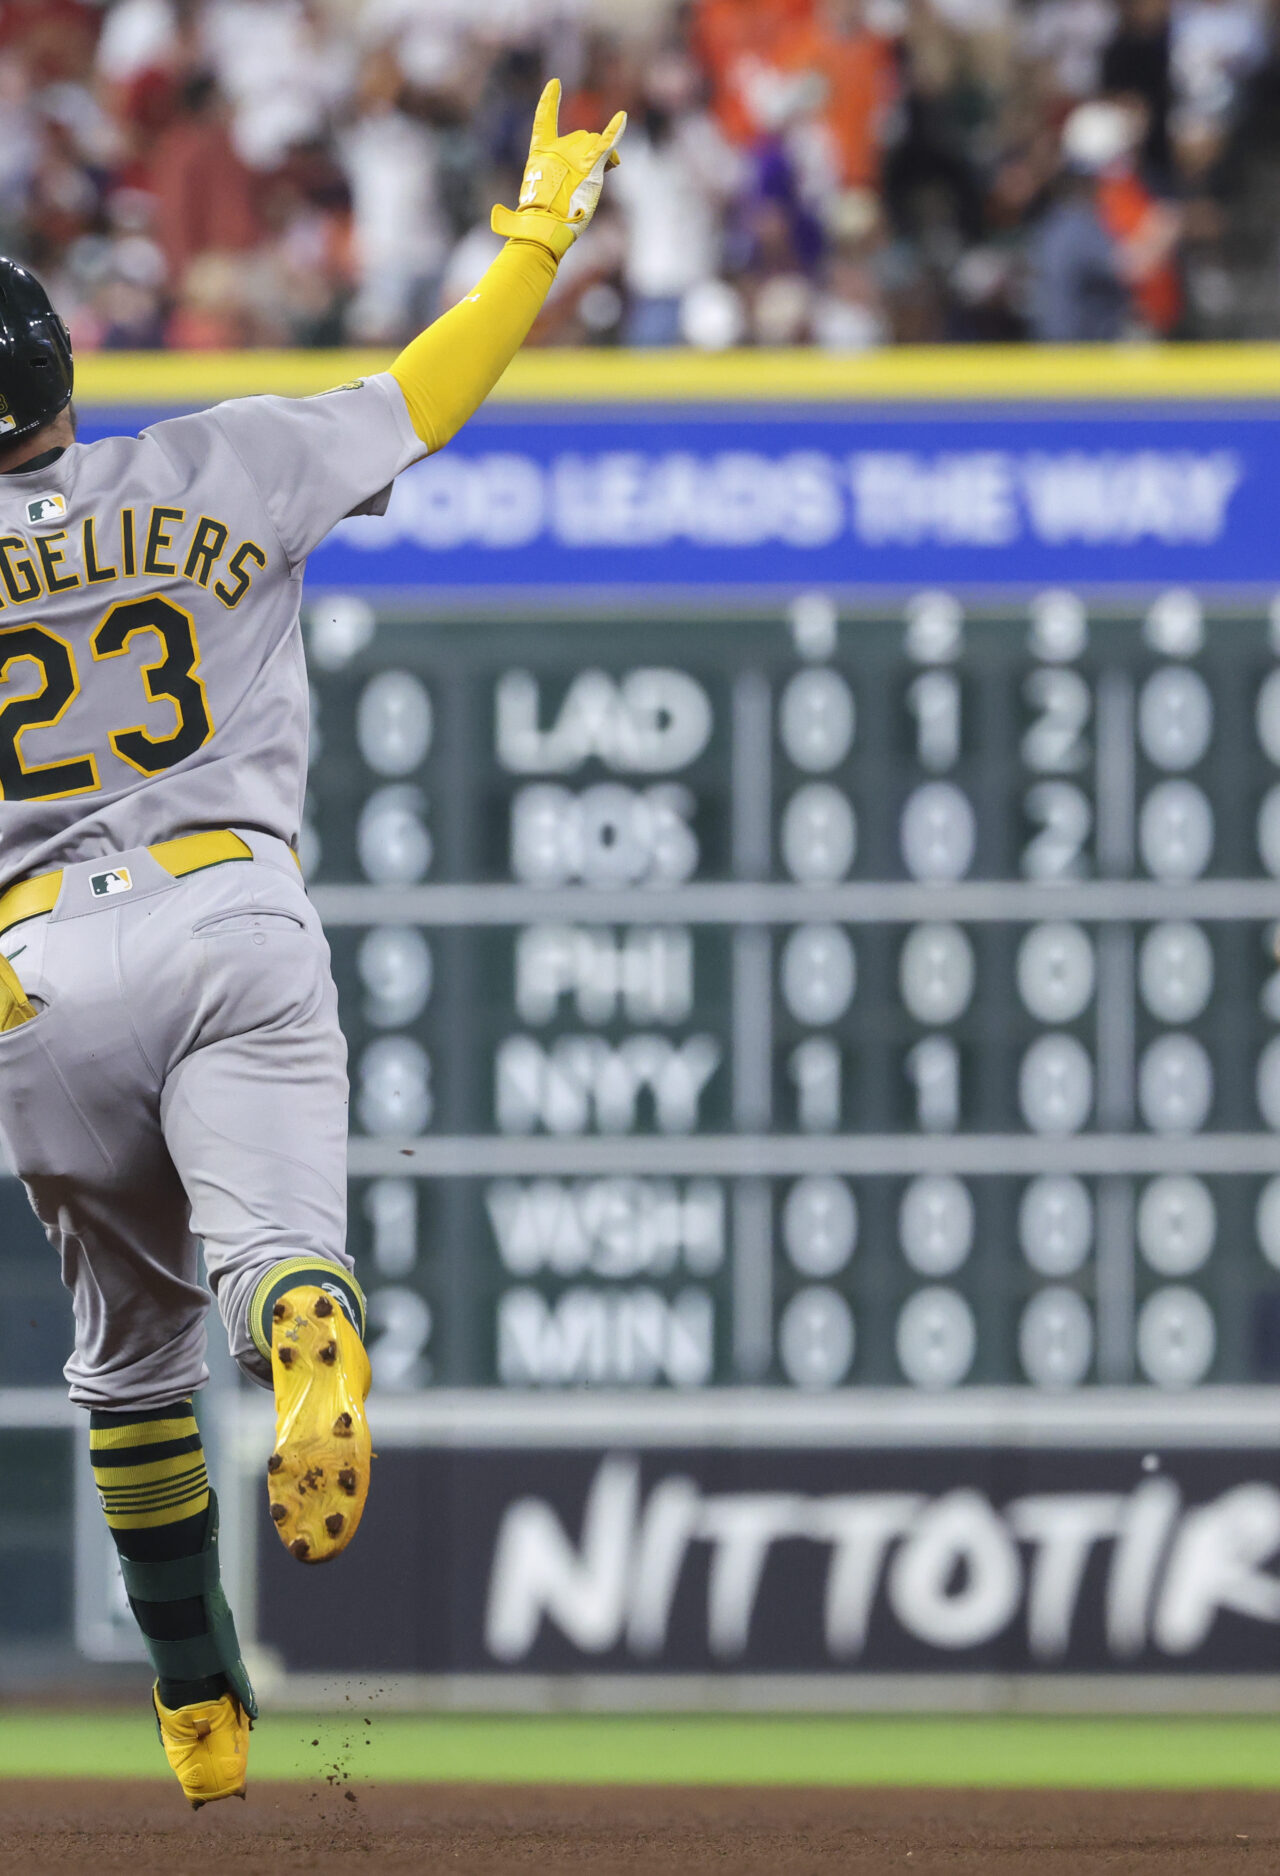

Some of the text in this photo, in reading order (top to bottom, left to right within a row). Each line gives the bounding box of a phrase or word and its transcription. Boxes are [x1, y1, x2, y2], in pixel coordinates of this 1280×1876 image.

[549, 452, 846, 548] LEADS
[850, 449, 1019, 547] THE
[1023, 448, 1243, 546] WAY
[496, 666, 711, 774] LAD
[779, 667, 855, 773] 0
[907, 667, 961, 773] 1
[1022, 667, 1091, 773] 2
[1139, 667, 1213, 773] 0
[511, 781, 698, 888] BOS
[781, 780, 856, 887] 0
[900, 780, 975, 887] 0
[1023, 780, 1091, 887] 2
[1139, 780, 1214, 887] 0
[516, 924, 693, 1027] PHI
[781, 921, 856, 1026] 0
[899, 921, 975, 1026] 0
[1018, 921, 1095, 1026] 0
[1139, 921, 1214, 1026] 0
[495, 1033, 721, 1136] NYY
[788, 1033, 840, 1136] 1
[906, 1033, 959, 1136] 1
[1021, 1033, 1093, 1136] 0
[1139, 1033, 1214, 1136] 0
[485, 1176, 724, 1278] WSH
[782, 1174, 857, 1277] 0
[900, 1174, 975, 1277] 0
[1021, 1174, 1093, 1277] 0
[1136, 1174, 1216, 1277] 0
[498, 1285, 714, 1387] MIN
[780, 1285, 855, 1388] 0
[896, 1285, 976, 1388] 0
[1022, 1285, 1093, 1388] 0
[1138, 1285, 1216, 1388] 0
